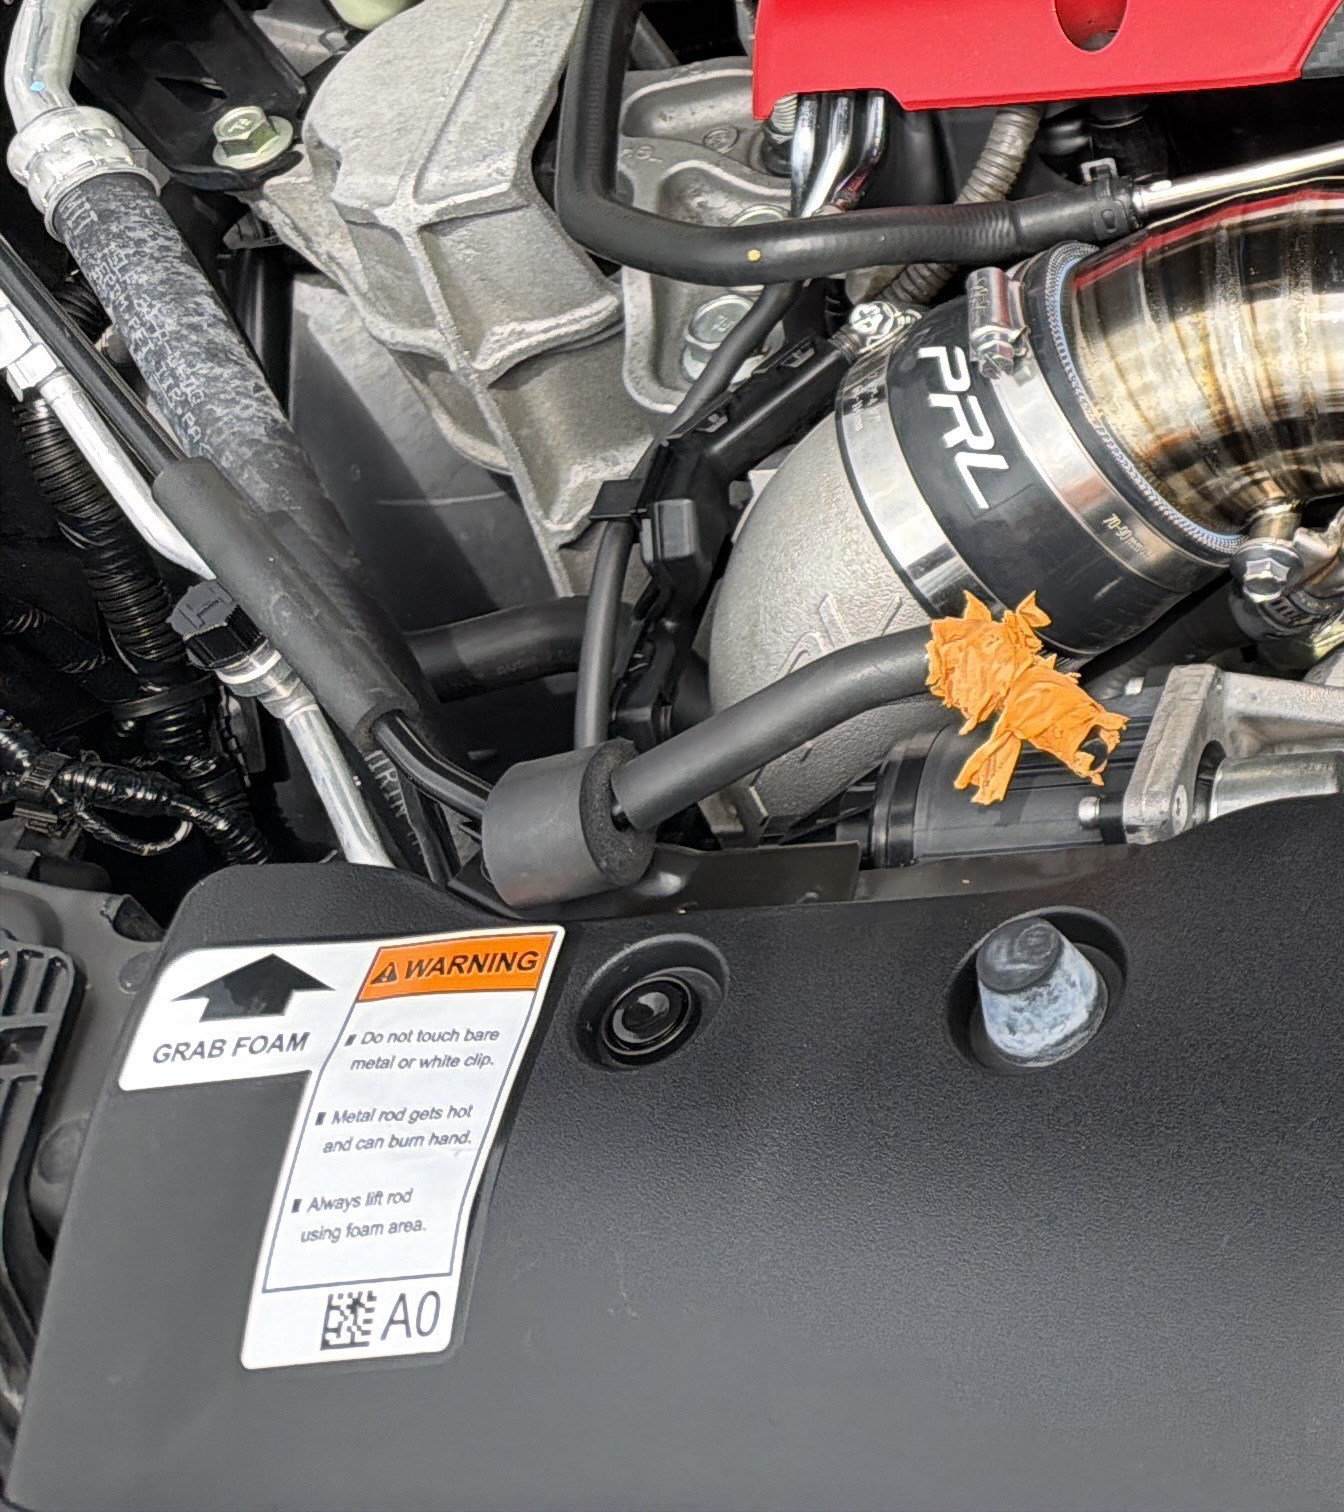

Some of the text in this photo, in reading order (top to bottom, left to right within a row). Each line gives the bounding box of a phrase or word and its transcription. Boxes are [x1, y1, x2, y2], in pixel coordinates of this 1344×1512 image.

[916, 345, 1010, 510] PRL
[404, 951, 539, 980] WARNING
[152, 1031, 310, 1064] GRAB FOAM
[360, 1028, 500, 1045] Do not touch bare
[350, 1052, 495, 1070] metal or white clip.
[331, 1104, 473, 1125] Metal rod gets hot
[322, 1129, 472, 1153] and can burn hand.
[306, 1188, 414, 1213] Always lift rod
[301, 1219, 427, 1244] using foam area.
[380, 1290, 441, 1341] A0
